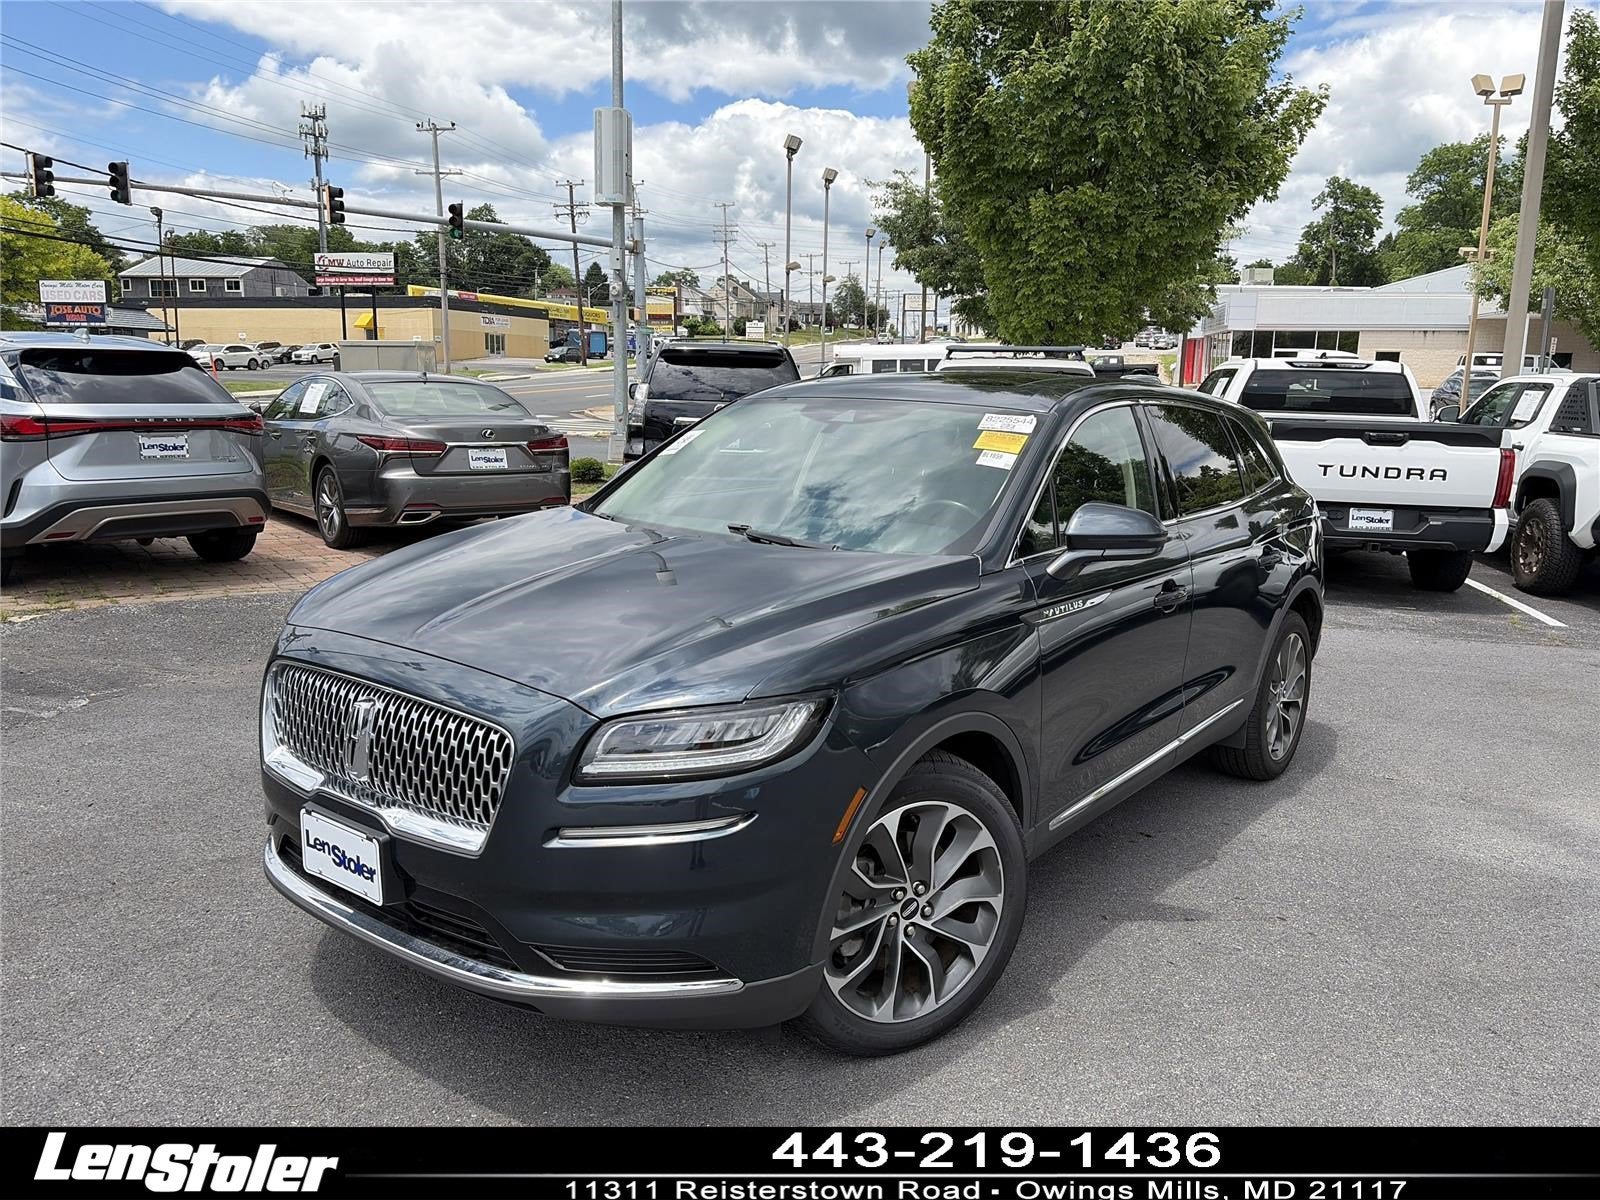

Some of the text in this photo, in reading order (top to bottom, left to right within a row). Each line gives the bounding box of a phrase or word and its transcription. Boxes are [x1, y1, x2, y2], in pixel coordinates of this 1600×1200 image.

[346, 259, 365, 268] Auto
[366, 259, 392, 269] Repair
[42, 290, 104, 301] USED CARS
[74, 305, 101, 315] AUTO
[142, 442, 186, 452] LenStoler
[470, 455, 504, 464] LenStoler
[1317, 464, 1448, 481] TUNDRA
[1352, 514, 1390, 524] LenStoler
[305, 828, 376, 883] LenStoler
